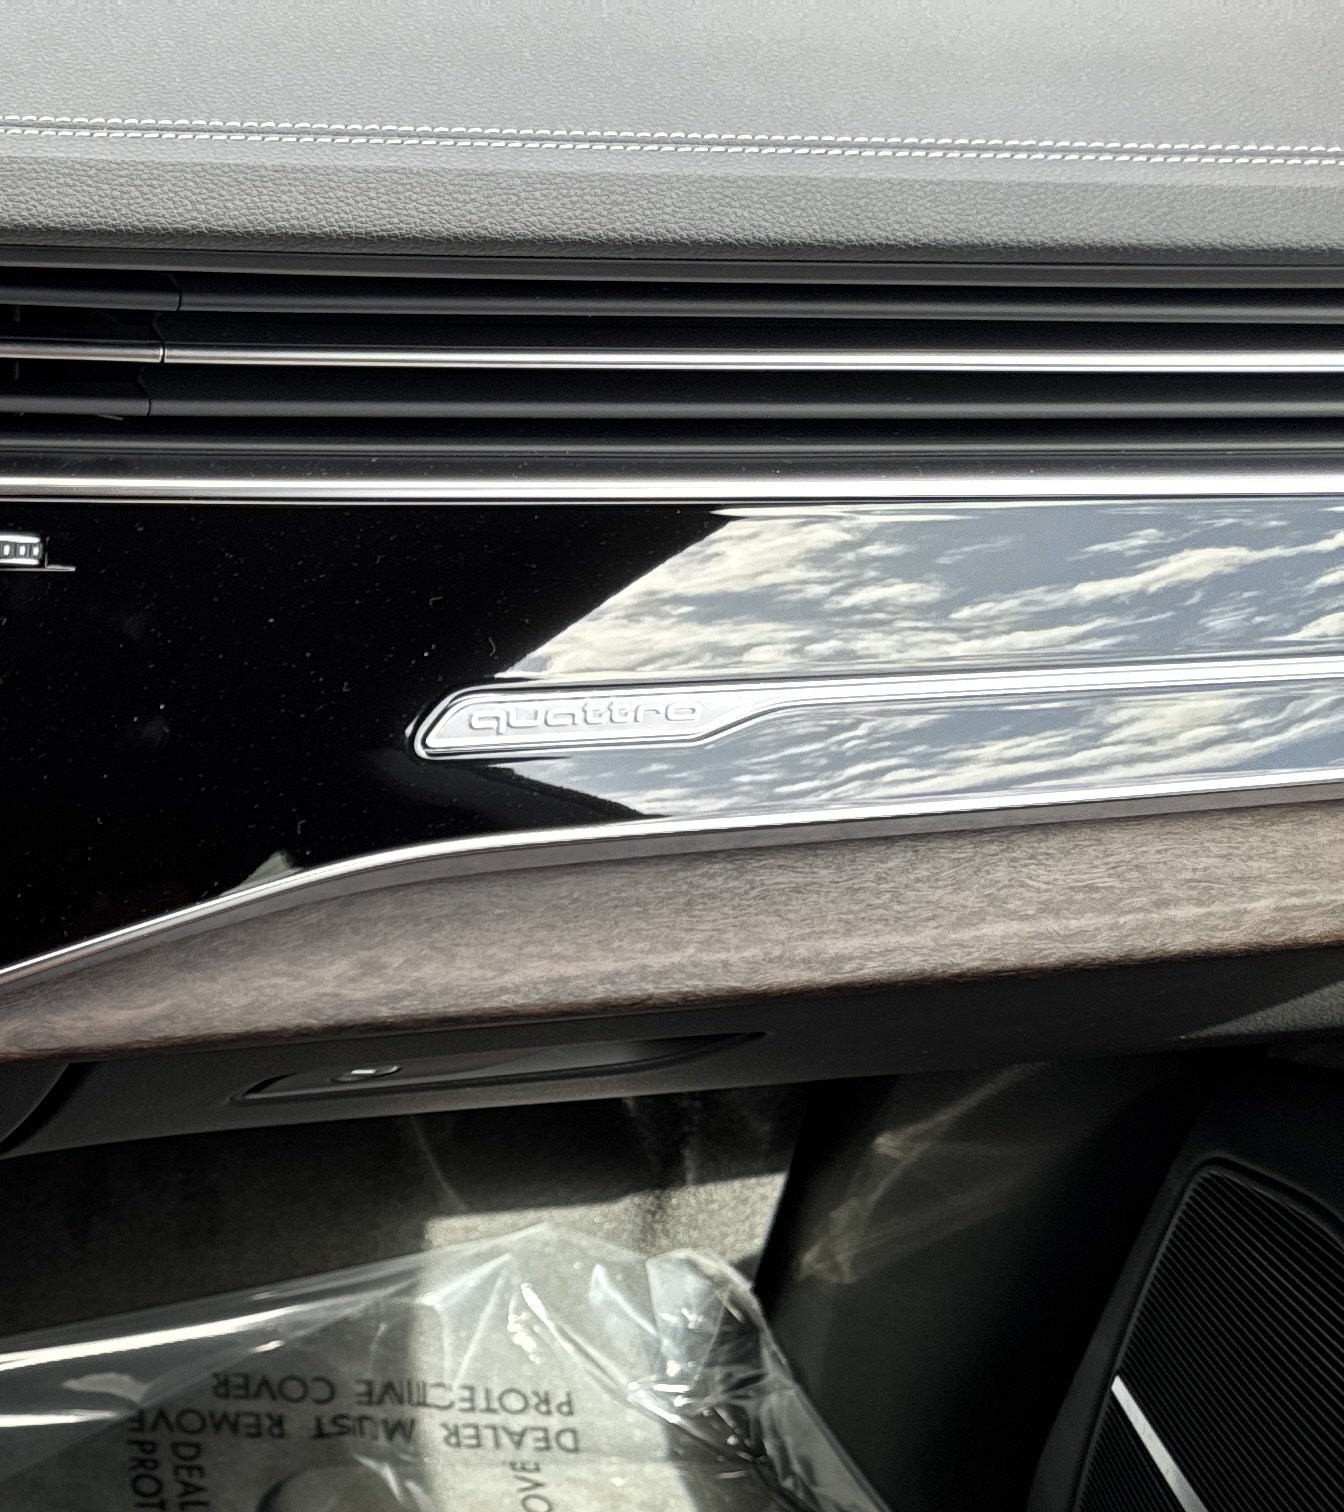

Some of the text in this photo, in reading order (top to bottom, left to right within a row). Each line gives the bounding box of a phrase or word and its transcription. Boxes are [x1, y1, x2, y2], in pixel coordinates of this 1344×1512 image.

[469, 701, 703, 735] quattro
[211, 1372, 575, 1416] PROTECTIVE COVER
[126, 1408, 580, 1454] DEALER MUST REMOVE
